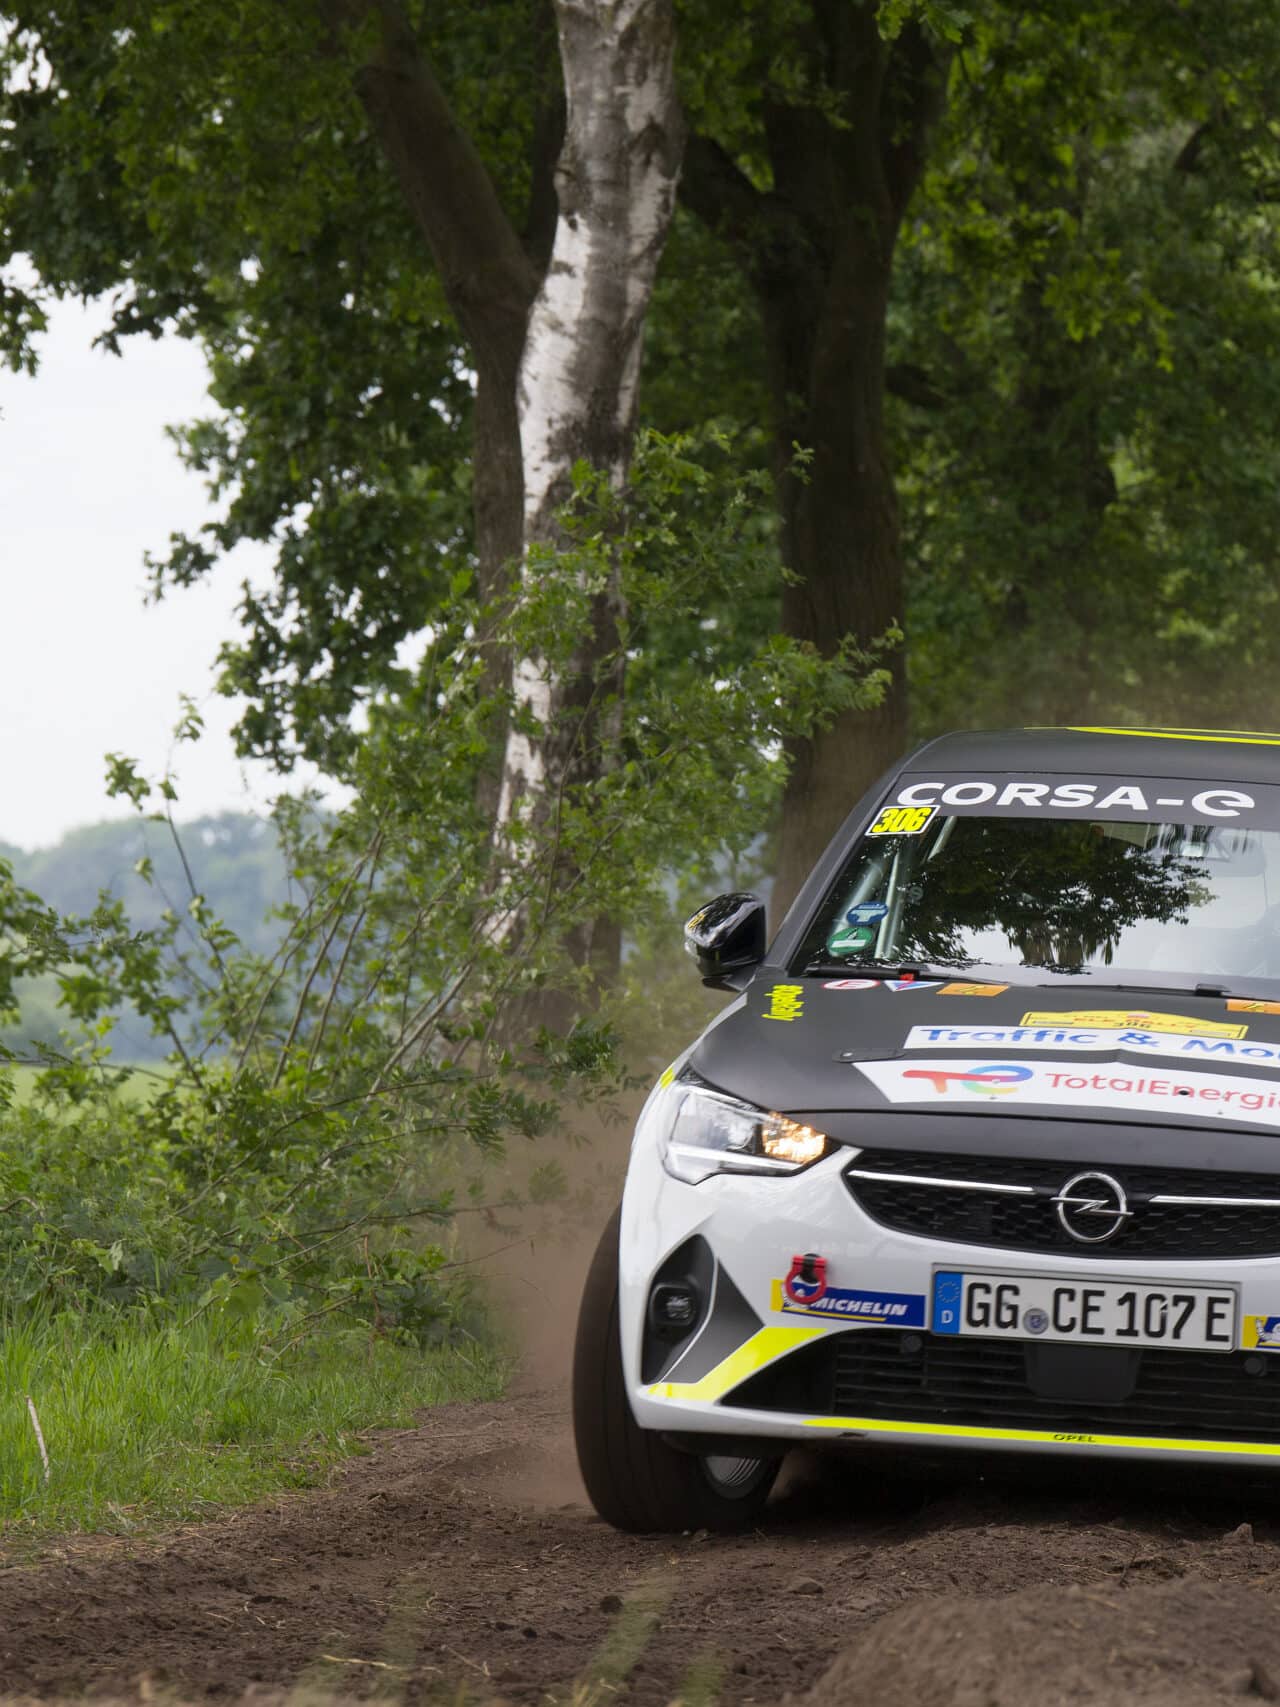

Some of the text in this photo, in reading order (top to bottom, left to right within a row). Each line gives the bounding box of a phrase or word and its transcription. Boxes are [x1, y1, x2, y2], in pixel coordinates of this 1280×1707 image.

[871, 807, 932, 833] 306
[918, 1028, 1098, 1045] Traffic
[1117, 1032, 1160, 1048] &
[811, 1297, 908, 1316] MICHELIN
[940, 1309, 953, 1324] D
[966, 1282, 1020, 1330] GG
[1052, 1286, 1105, 1335] CE
[1054, 1433, 1096, 1443] OPEL
